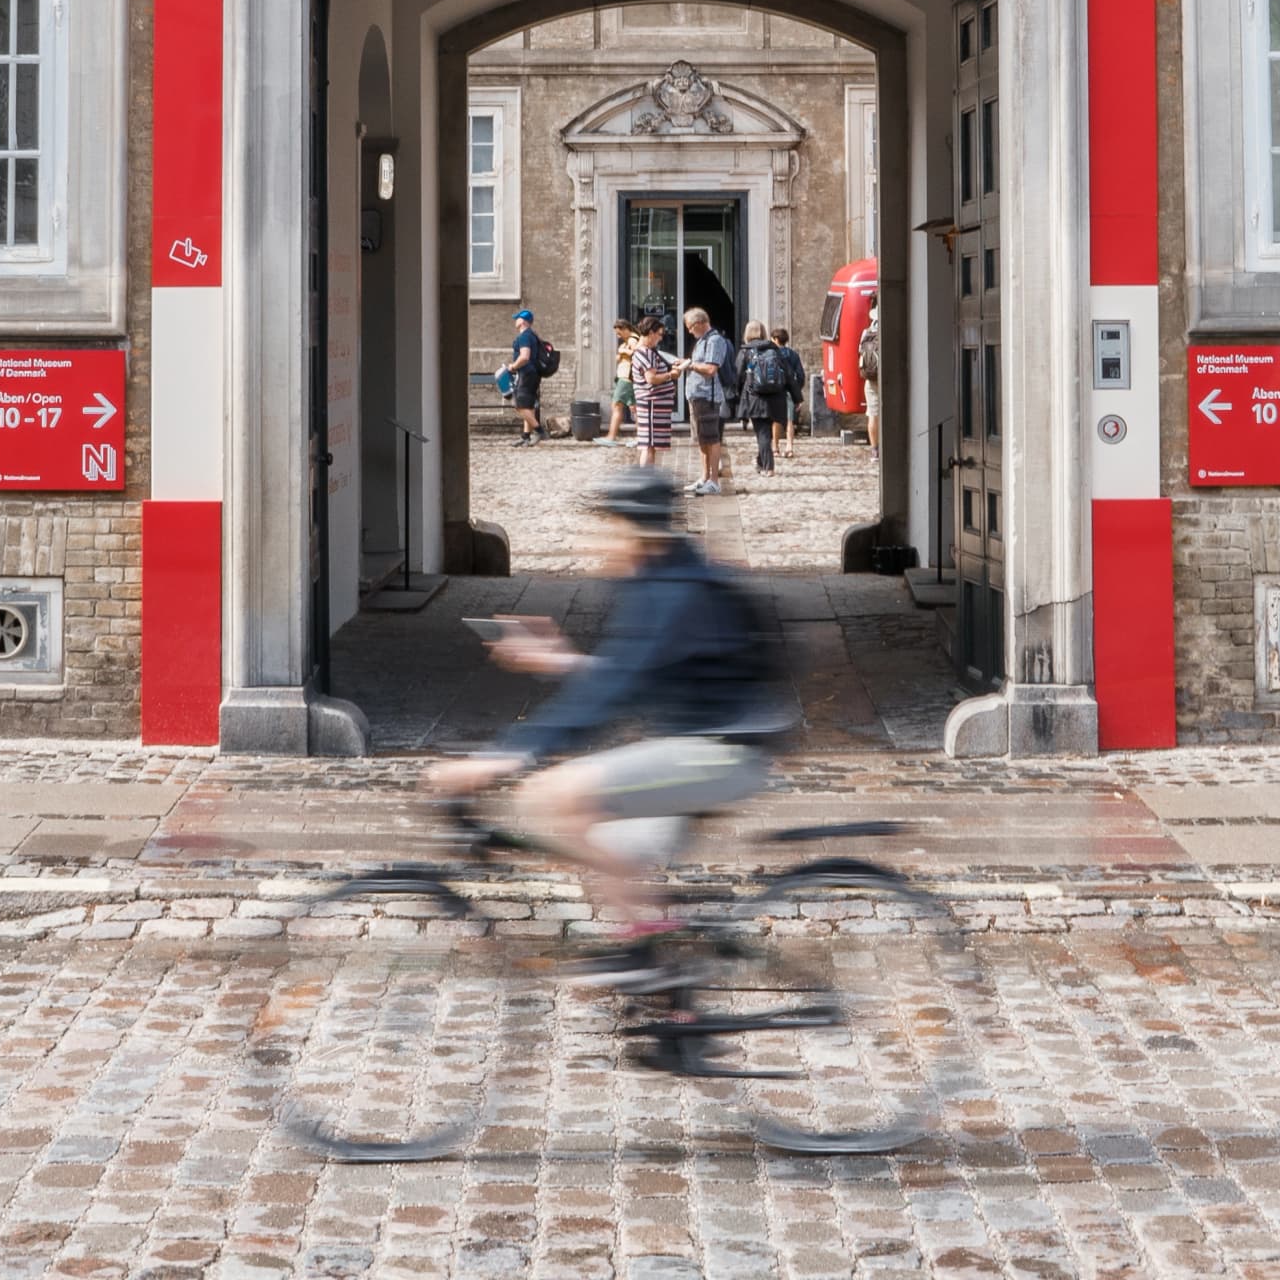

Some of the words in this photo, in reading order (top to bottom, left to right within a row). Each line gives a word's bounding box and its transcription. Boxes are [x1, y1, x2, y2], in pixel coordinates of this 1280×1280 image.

[33, 358, 72, 368] Museum
[1196, 354, 1234, 364] National
[1235, 354, 1274, 364] Museum
[6, 368, 47, 378] Denmark
[1197, 364, 1208, 374] of
[1208, 364, 1249, 374] Denmark
[32, 393, 62, 406] Open
